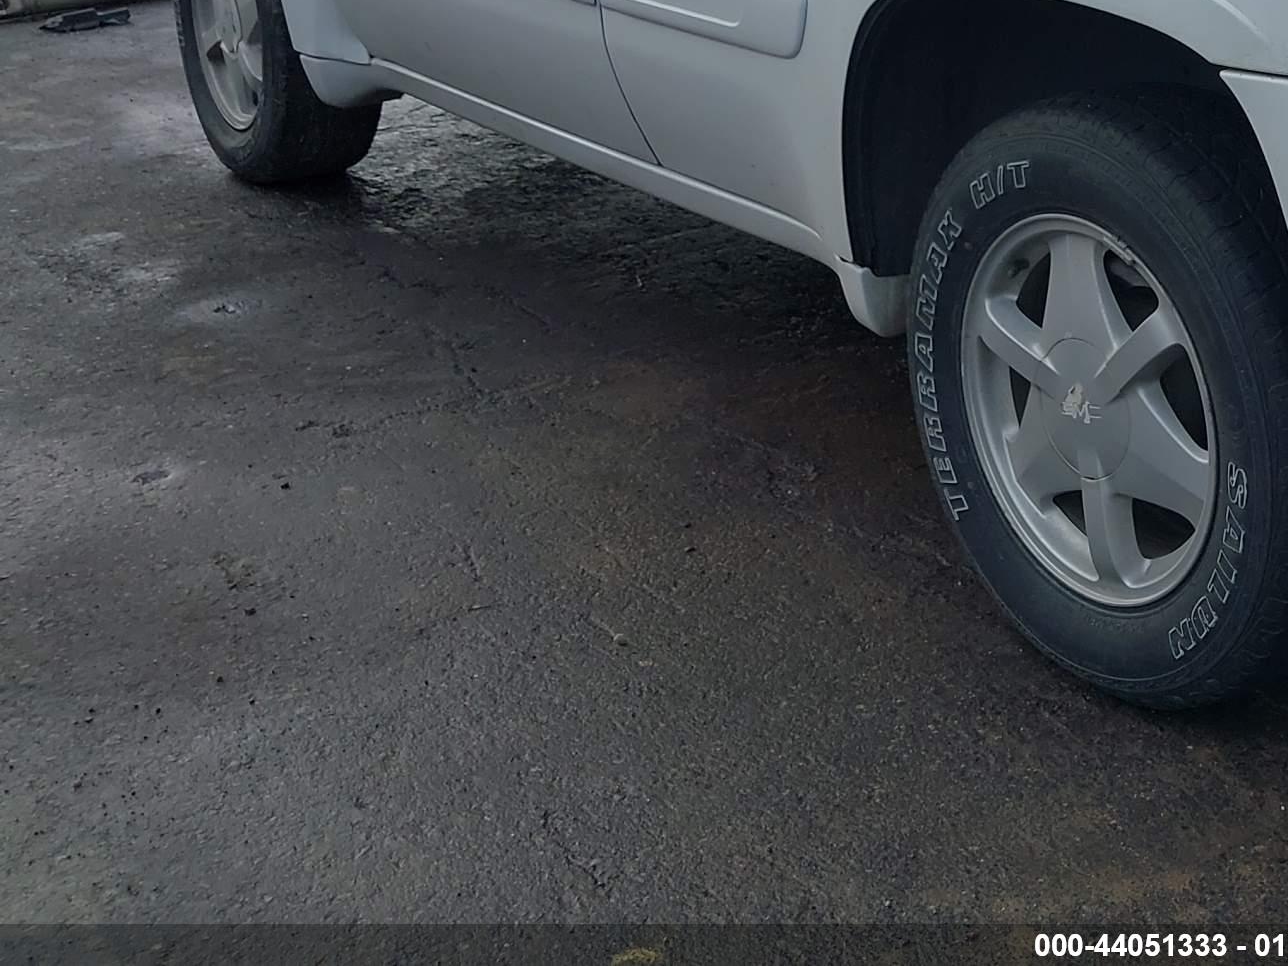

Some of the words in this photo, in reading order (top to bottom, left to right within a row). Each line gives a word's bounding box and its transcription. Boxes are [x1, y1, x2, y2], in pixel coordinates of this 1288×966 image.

[914, 208, 970, 522] TERRAMAX
[968, 160, 1030, 210] H/T
[1167, 461, 1248, 660] SAILUN
